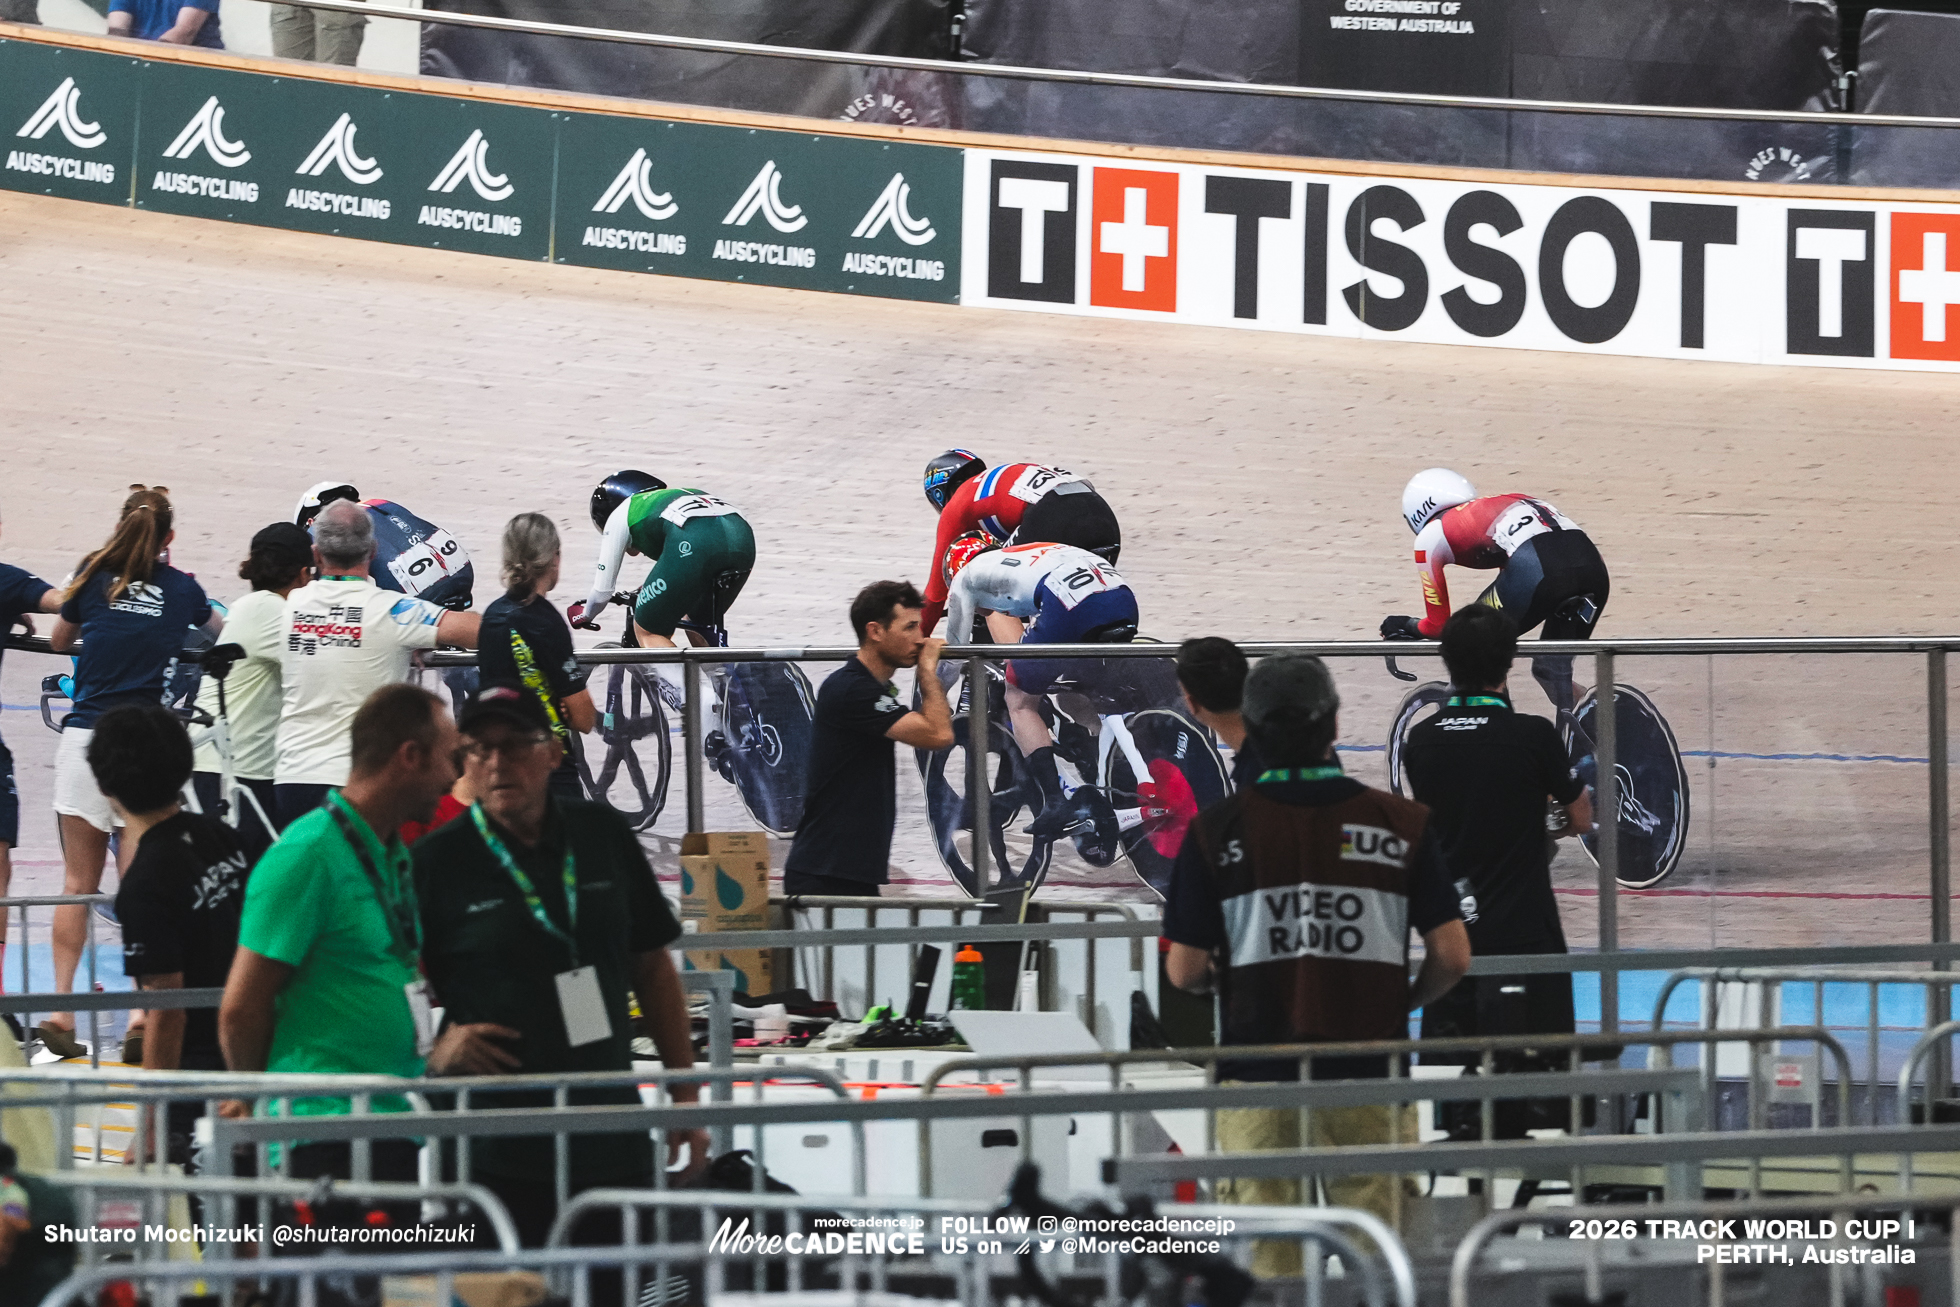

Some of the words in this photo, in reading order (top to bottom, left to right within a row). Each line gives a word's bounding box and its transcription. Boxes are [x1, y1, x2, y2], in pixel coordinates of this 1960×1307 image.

[1345, 0, 1440, 14] GOVERNMENT
[1441, 2, 1461, 15] OF
[1330, 16, 1397, 30] WESTERN
[1398, 19, 1474, 33] AUSTRALIA
[6, 151, 114, 183] AUSCYCLING
[153, 171, 258, 202] AUSCYCLING
[286, 188, 390, 219] AUSCYCLING
[418, 206, 521, 236] AUSCYCLING
[582, 227, 686, 255] AUSCYCLING
[713, 240, 815, 268] AUSCYCLING
[842, 253, 944, 281] AUSCYCLING
[1205, 175, 1738, 349] TISSOT
[1507, 515, 1533, 537] 3
[1063, 566, 1094, 590] 10
[320, 635, 362, 648] China
